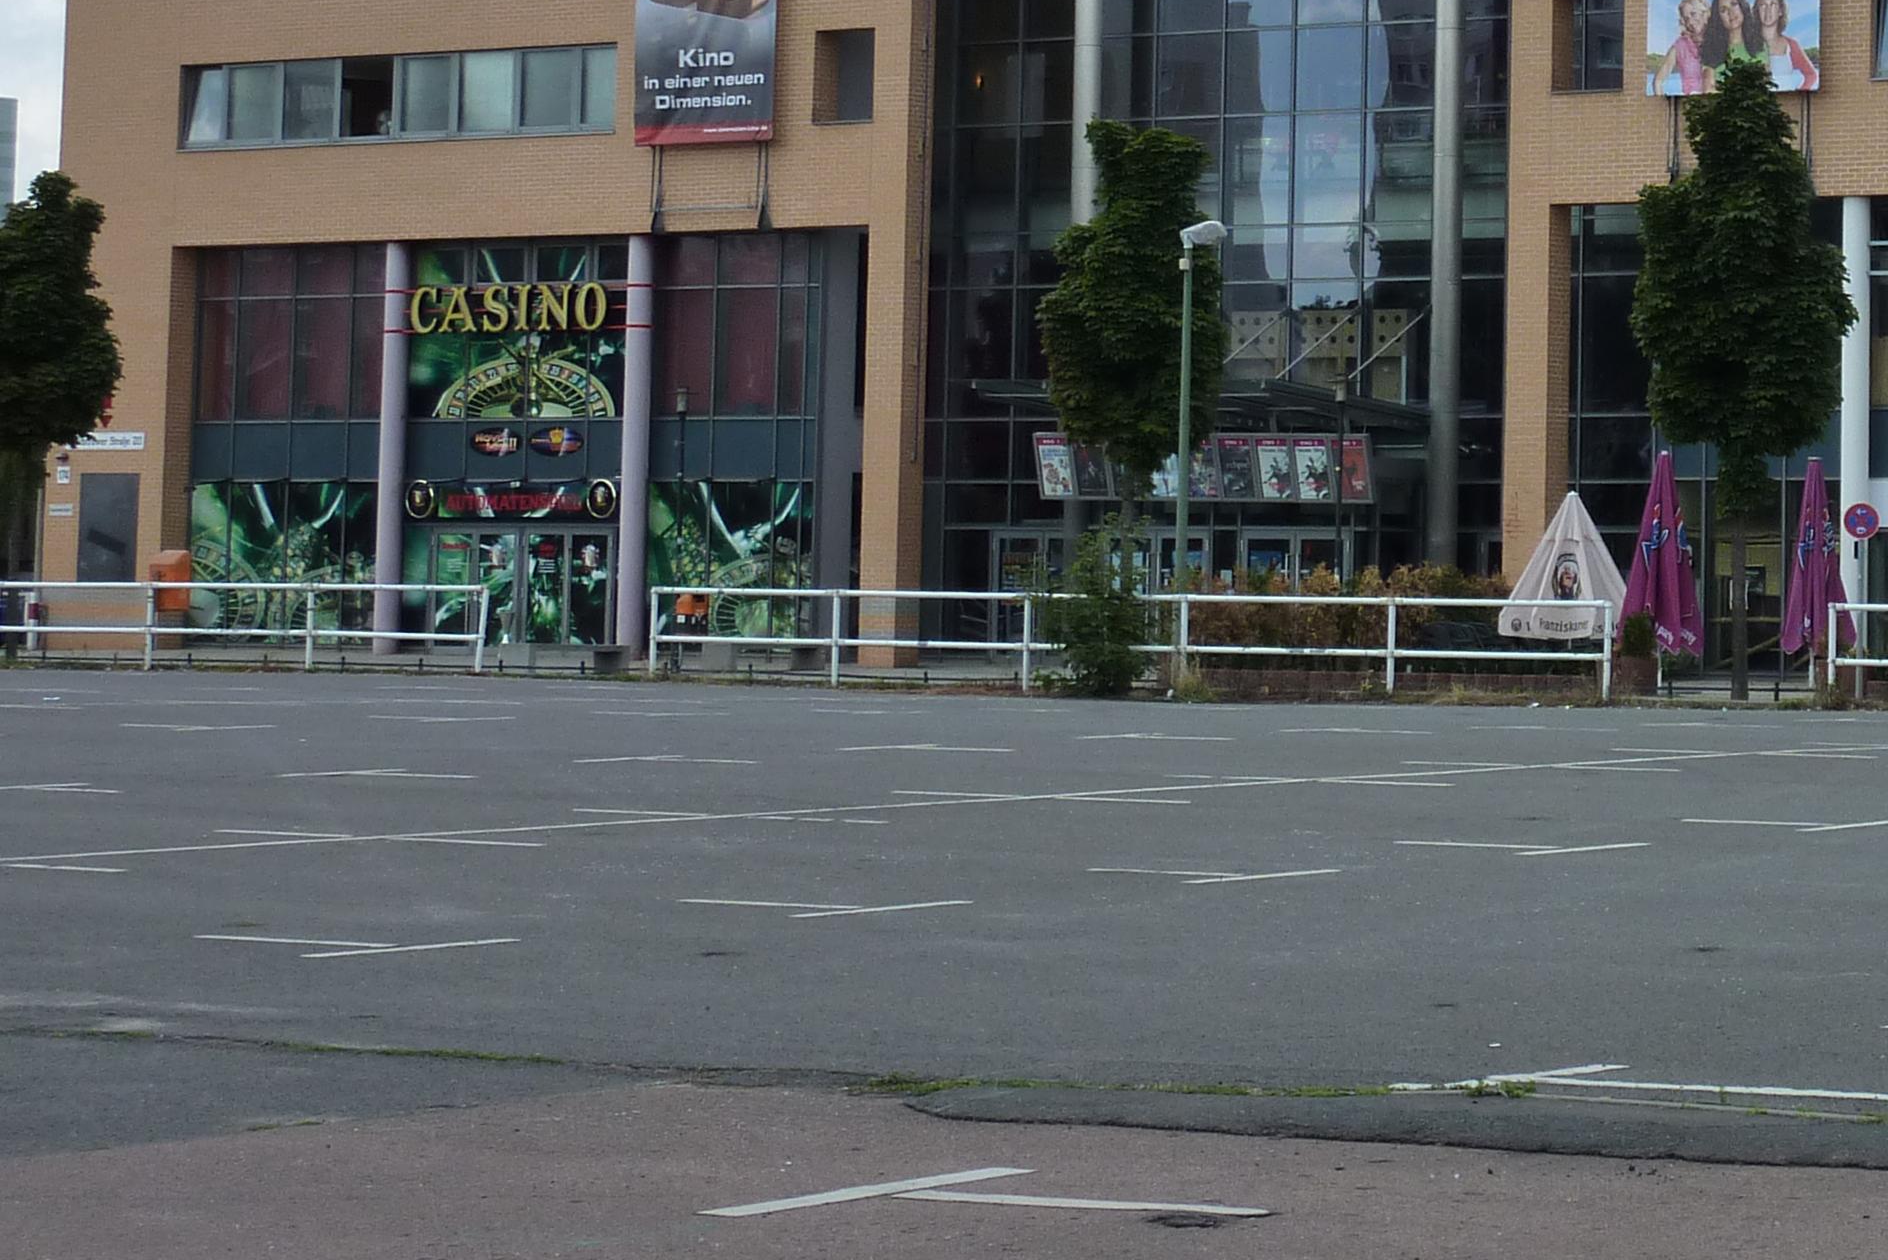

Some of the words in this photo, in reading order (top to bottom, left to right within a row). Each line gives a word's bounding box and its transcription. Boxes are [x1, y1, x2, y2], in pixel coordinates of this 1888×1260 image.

[678, 49, 734, 68] Kino
[644, 75, 659, 90] in
[665, 74, 709, 89] einer
[714, 72, 764, 86] neuen
[655, 92, 752, 110] Dimension.
[410, 282, 607, 334] CASINO
